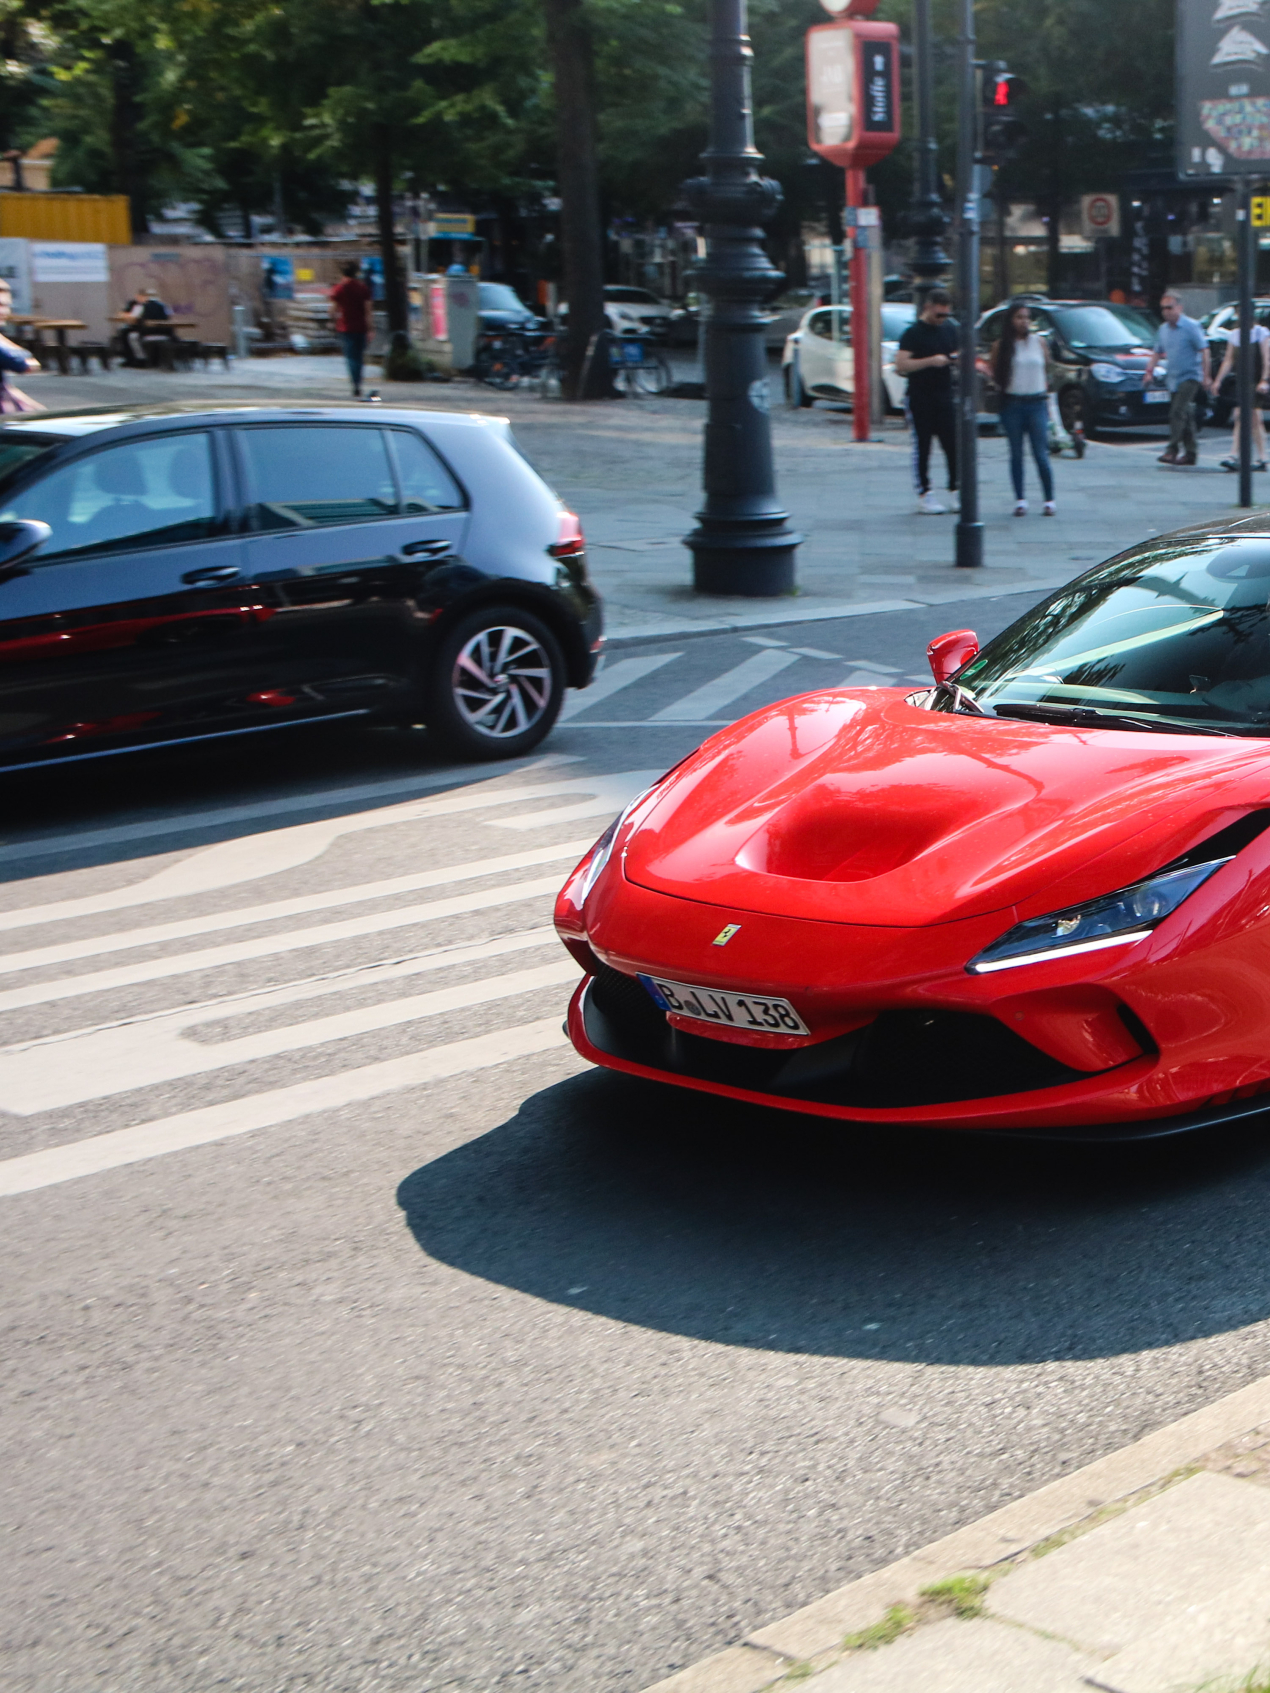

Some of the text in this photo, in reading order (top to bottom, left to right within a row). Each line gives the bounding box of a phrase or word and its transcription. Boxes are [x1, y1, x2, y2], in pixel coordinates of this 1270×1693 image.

[655, 982, 800, 1030] B LV 138
